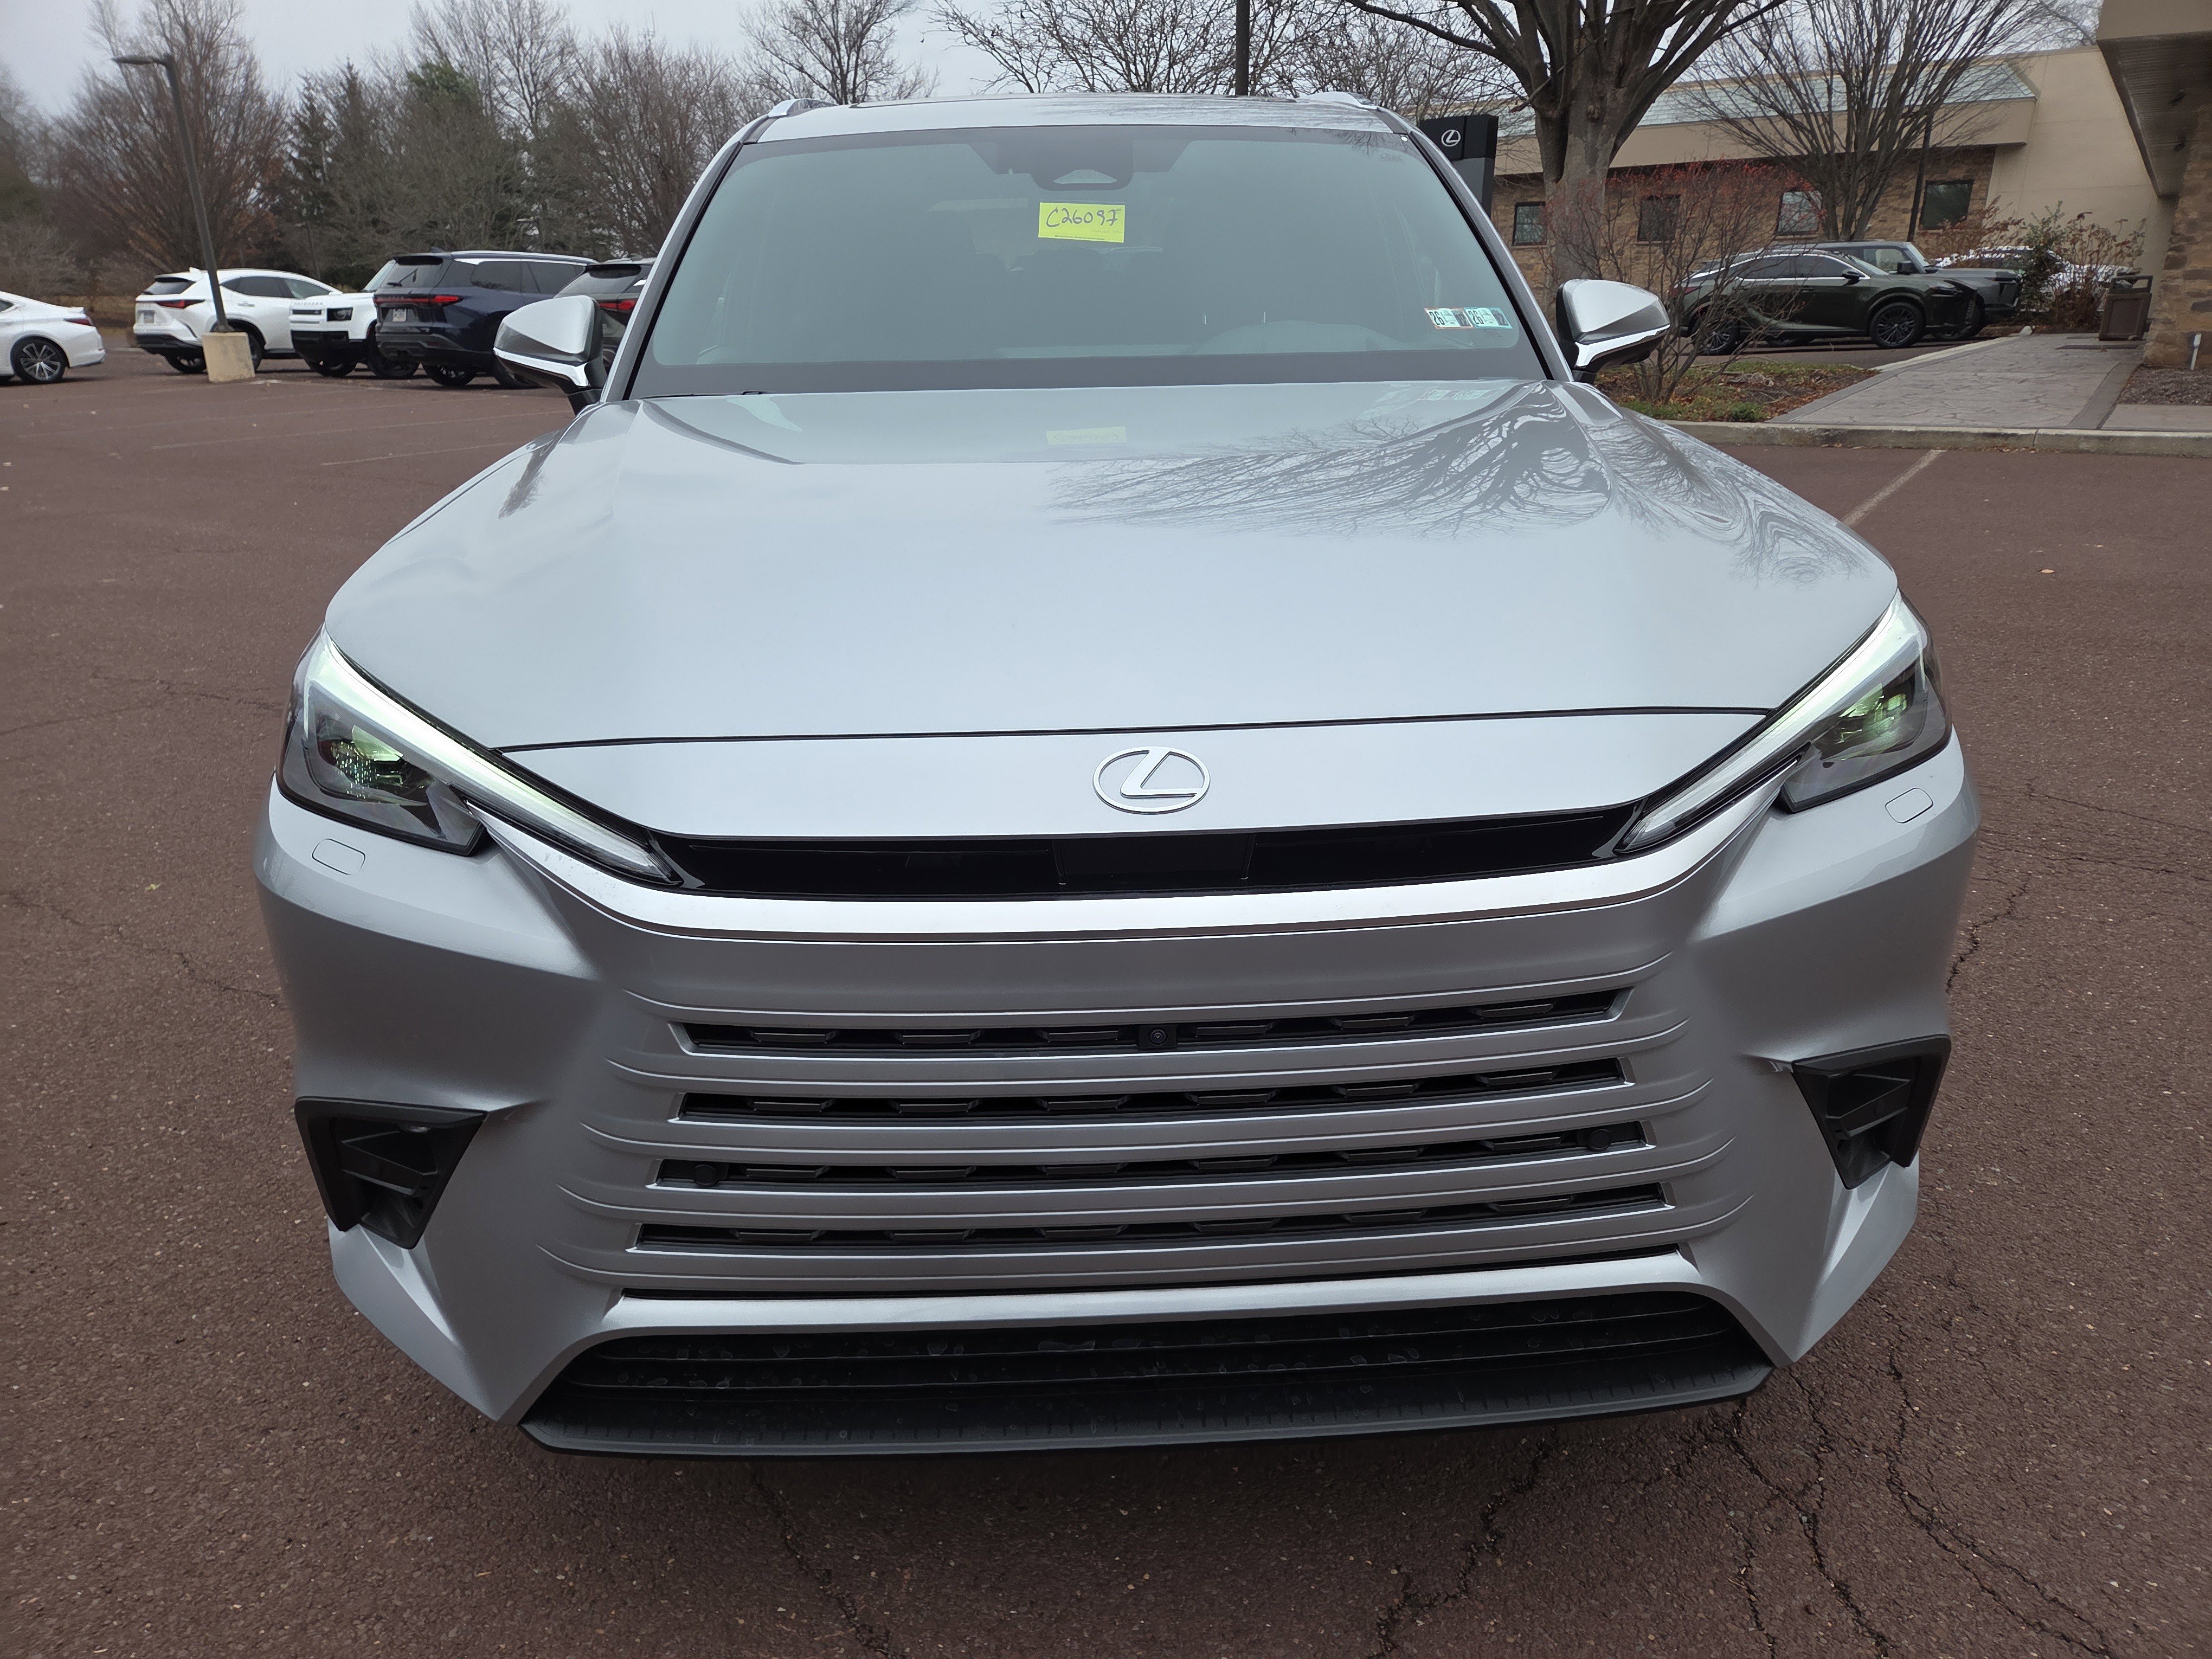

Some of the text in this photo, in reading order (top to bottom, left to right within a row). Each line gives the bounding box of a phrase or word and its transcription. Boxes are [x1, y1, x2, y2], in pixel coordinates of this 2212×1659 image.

[1046, 207, 1118, 228] C26097
[1429, 311, 1445, 325] 26
[1468, 310, 1484, 325] 26
